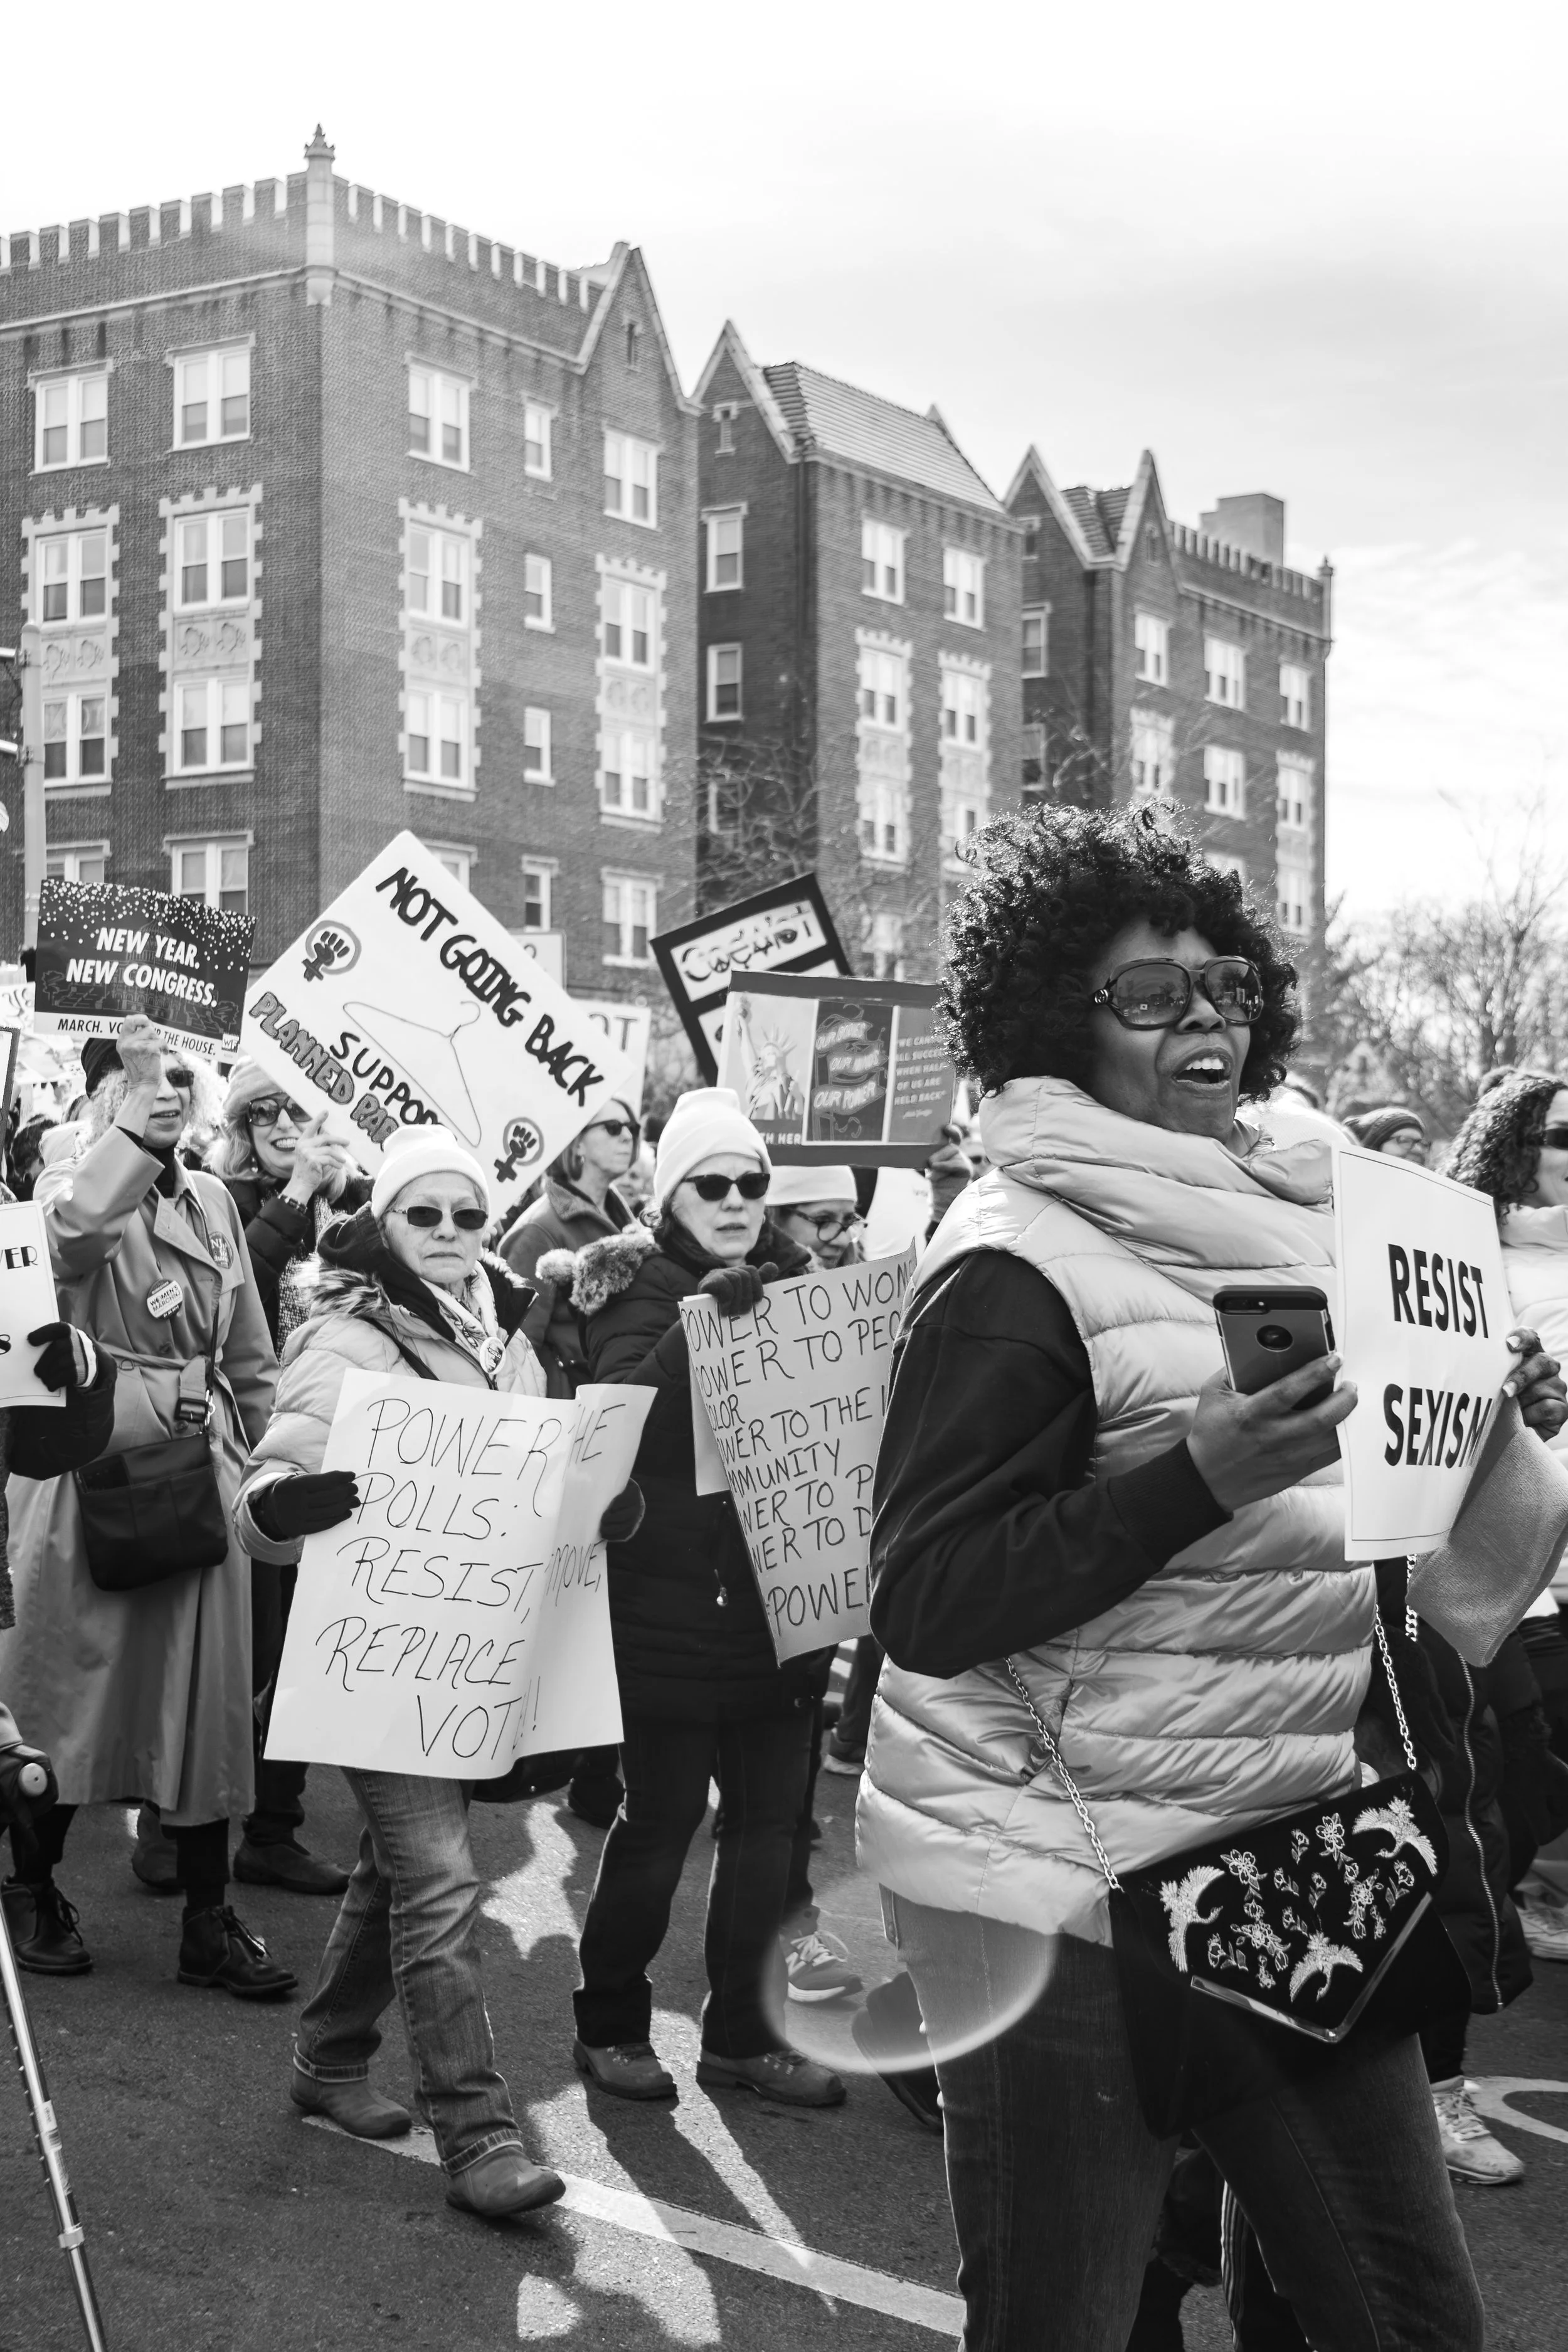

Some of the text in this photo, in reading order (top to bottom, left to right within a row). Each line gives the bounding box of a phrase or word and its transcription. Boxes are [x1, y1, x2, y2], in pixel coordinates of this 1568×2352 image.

[97, 927, 200, 970] NEW YEAR.
[66, 958, 218, 1008] NEW CONGRESS.
[376, 867, 604, 1107] NOT GOING BACK
[58, 1018, 103, 1034] MARCH.
[164, 1030, 179, 1046] THE
[182, 1039, 216, 1056] HOUSE.
[248, 990, 354, 1104] PLANNED
[829, 1056, 853, 1072] OUR
[329, 1032, 438, 1125] SUPPO
[813, 1081, 876, 1110] OUR POWER
[778, 1133, 802, 1145] HER
[0, 1245, 38, 1269] ER
[783, 1284, 831, 1325] TO
[1388, 1243, 1489, 1339] RESIST
[793, 1330, 842, 1370] TO
[847, 1310, 901, 1355] PEO
[770, 1409, 808, 1444] TO
[810, 1386, 872, 1432] THE
[368, 1399, 562, 1517] POWER
[739, 1490, 790, 1536] WER
[795, 1479, 834, 1515] TO
[803, 1516, 845, 1551] TO
[768, 1565, 871, 1637] POWE
[315, 1616, 525, 1692] REPLACE
